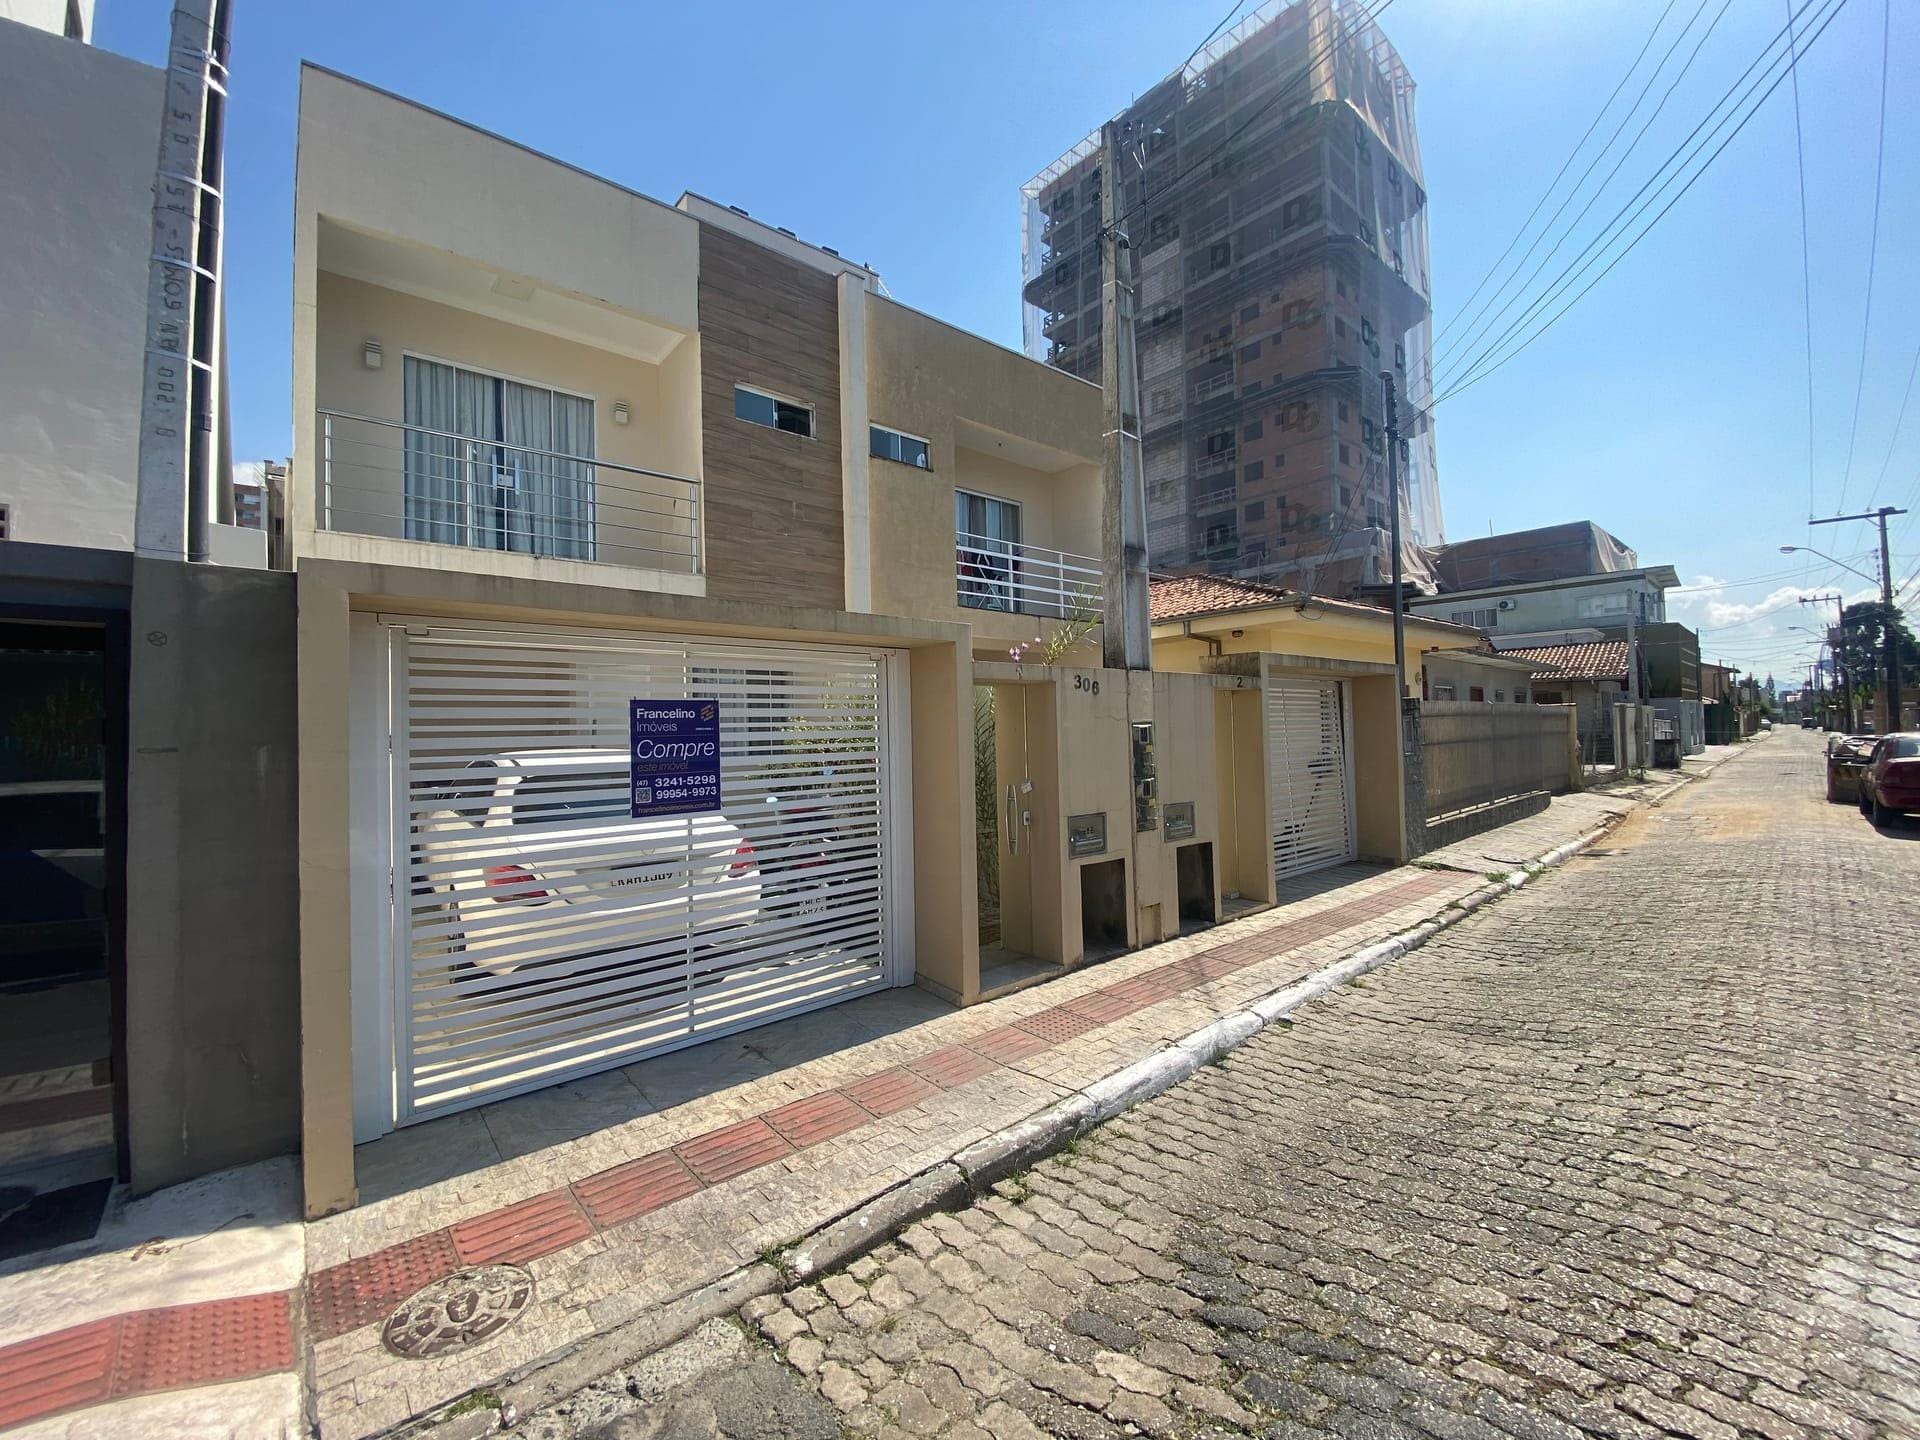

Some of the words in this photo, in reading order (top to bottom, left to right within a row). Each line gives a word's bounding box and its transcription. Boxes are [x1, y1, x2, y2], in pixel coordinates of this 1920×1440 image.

[1073, 674, 1100, 696] 306
[1236, 676, 1246, 689] 2
[636, 708, 696, 719] Francelino
[636, 721, 678, 732] Imóveis
[636, 739, 715, 761] Compre
[636, 779, 649, 787] (47)
[654, 774, 717, 788] 3241-5298
[655, 786, 717, 800] 99954-9973
